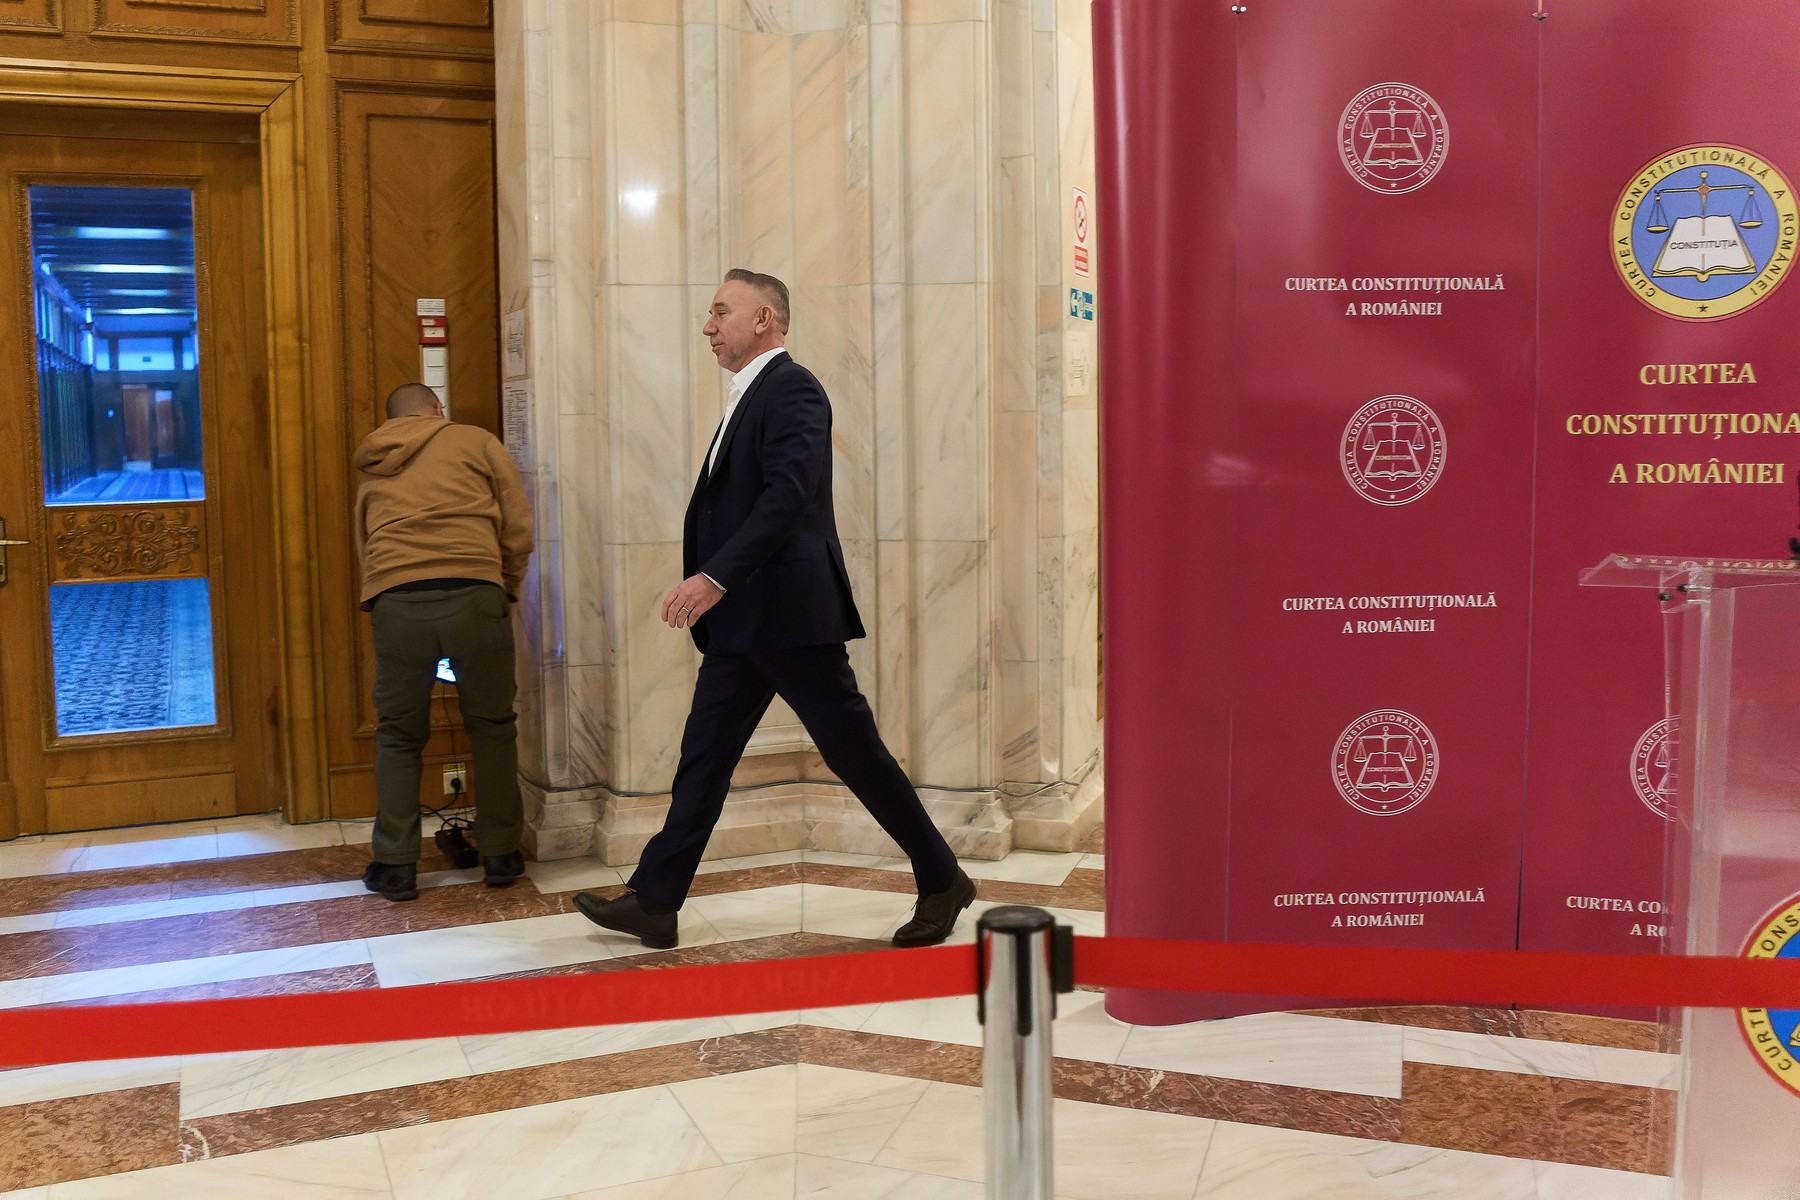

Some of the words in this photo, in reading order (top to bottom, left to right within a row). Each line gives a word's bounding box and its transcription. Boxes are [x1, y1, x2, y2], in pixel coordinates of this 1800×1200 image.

[1618, 236, 1656, 297] CURTEA
[1773, 189, 1786, 200] A
[1285, 277, 1348, 291] CURTEA
[1351, 274, 1505, 294] CONSTITUȚIONALĂ
[1345, 302, 1357, 316] A
[1361, 299, 1443, 316] ROMÂNIEI
[1640, 362, 1757, 385] CURTEA
[1608, 463, 1629, 484] A
[1635, 457, 1785, 484] ROMÂNIEI
[1282, 597, 1345, 611] CURTEA
[1348, 591, 1497, 611] CONSTITUȚIONALĂ
[1342, 621, 1353, 634] A
[1357, 616, 1436, 634] ROMÂNIEI
[1274, 893, 1335, 907] CURTEA
[1338, 888, 1485, 907] CONSTITUȚIONALĂ
[1566, 896, 1634, 912] CURTEA
[1331, 915, 1343, 928] A
[1346, 911, 1425, 927] ROMÂNIEI
[1630, 923, 1642, 936] A
[1754, 908, 1800, 958] ONS
[1748, 1007, 1793, 1071] CURT
